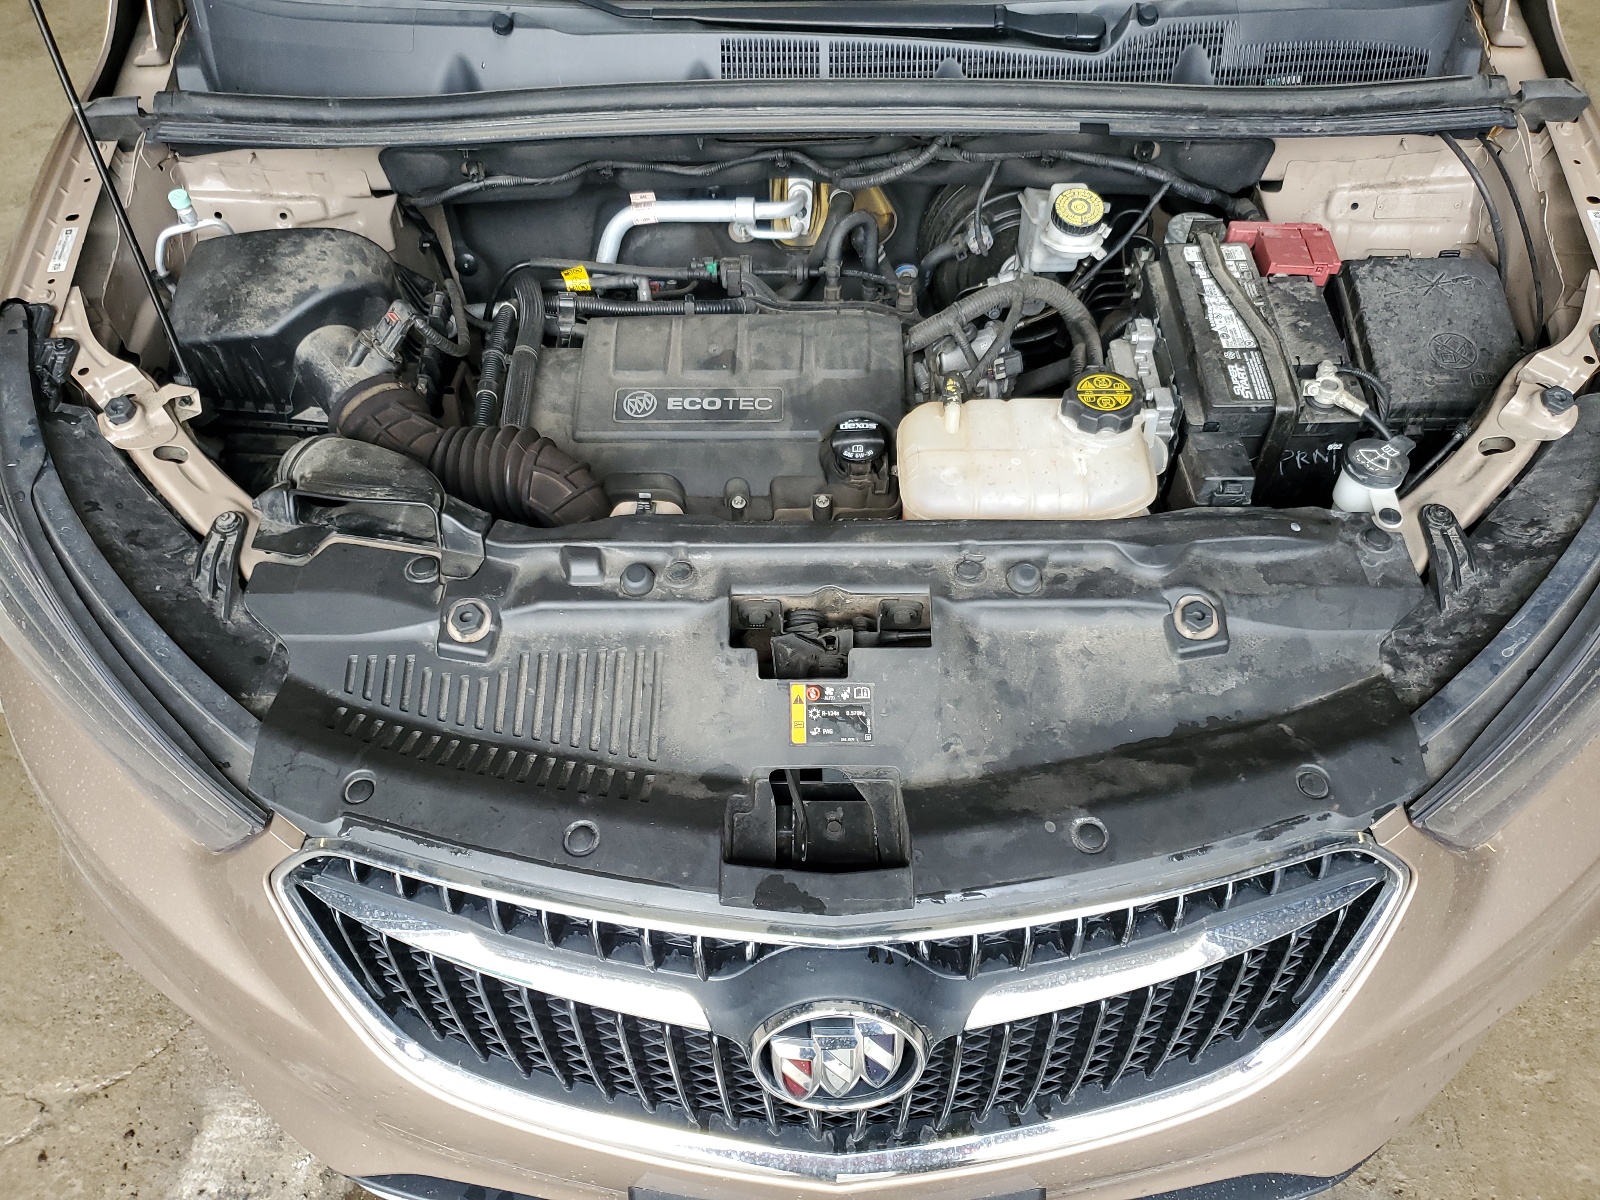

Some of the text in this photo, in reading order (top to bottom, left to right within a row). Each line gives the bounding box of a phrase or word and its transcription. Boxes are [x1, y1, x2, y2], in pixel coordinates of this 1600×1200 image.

[1227, 364, 1241, 396] SUPER
[667, 397, 773, 410] ECOTEC
[839, 421, 877, 429] dexos
